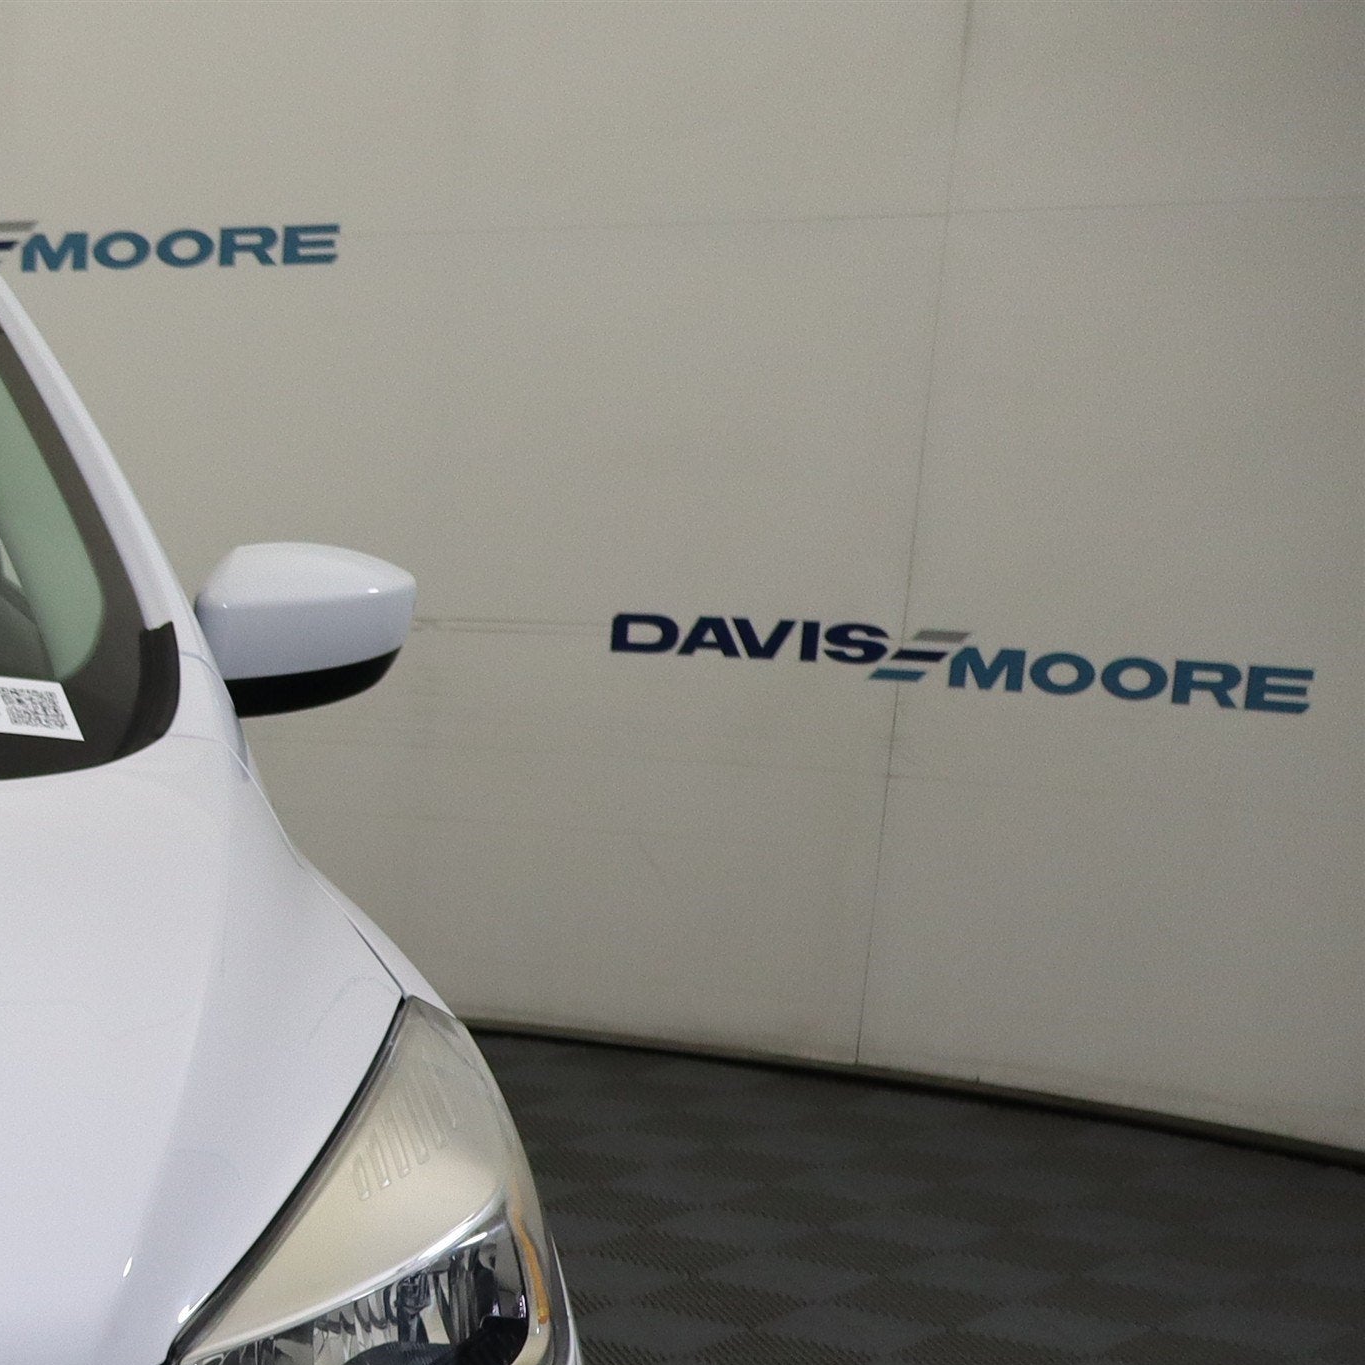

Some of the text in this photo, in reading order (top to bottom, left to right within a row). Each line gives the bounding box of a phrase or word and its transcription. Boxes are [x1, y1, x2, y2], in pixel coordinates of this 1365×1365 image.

[20, 224, 341, 273] MOORE
[610, 612, 1315, 714] DAVIS MOORE
